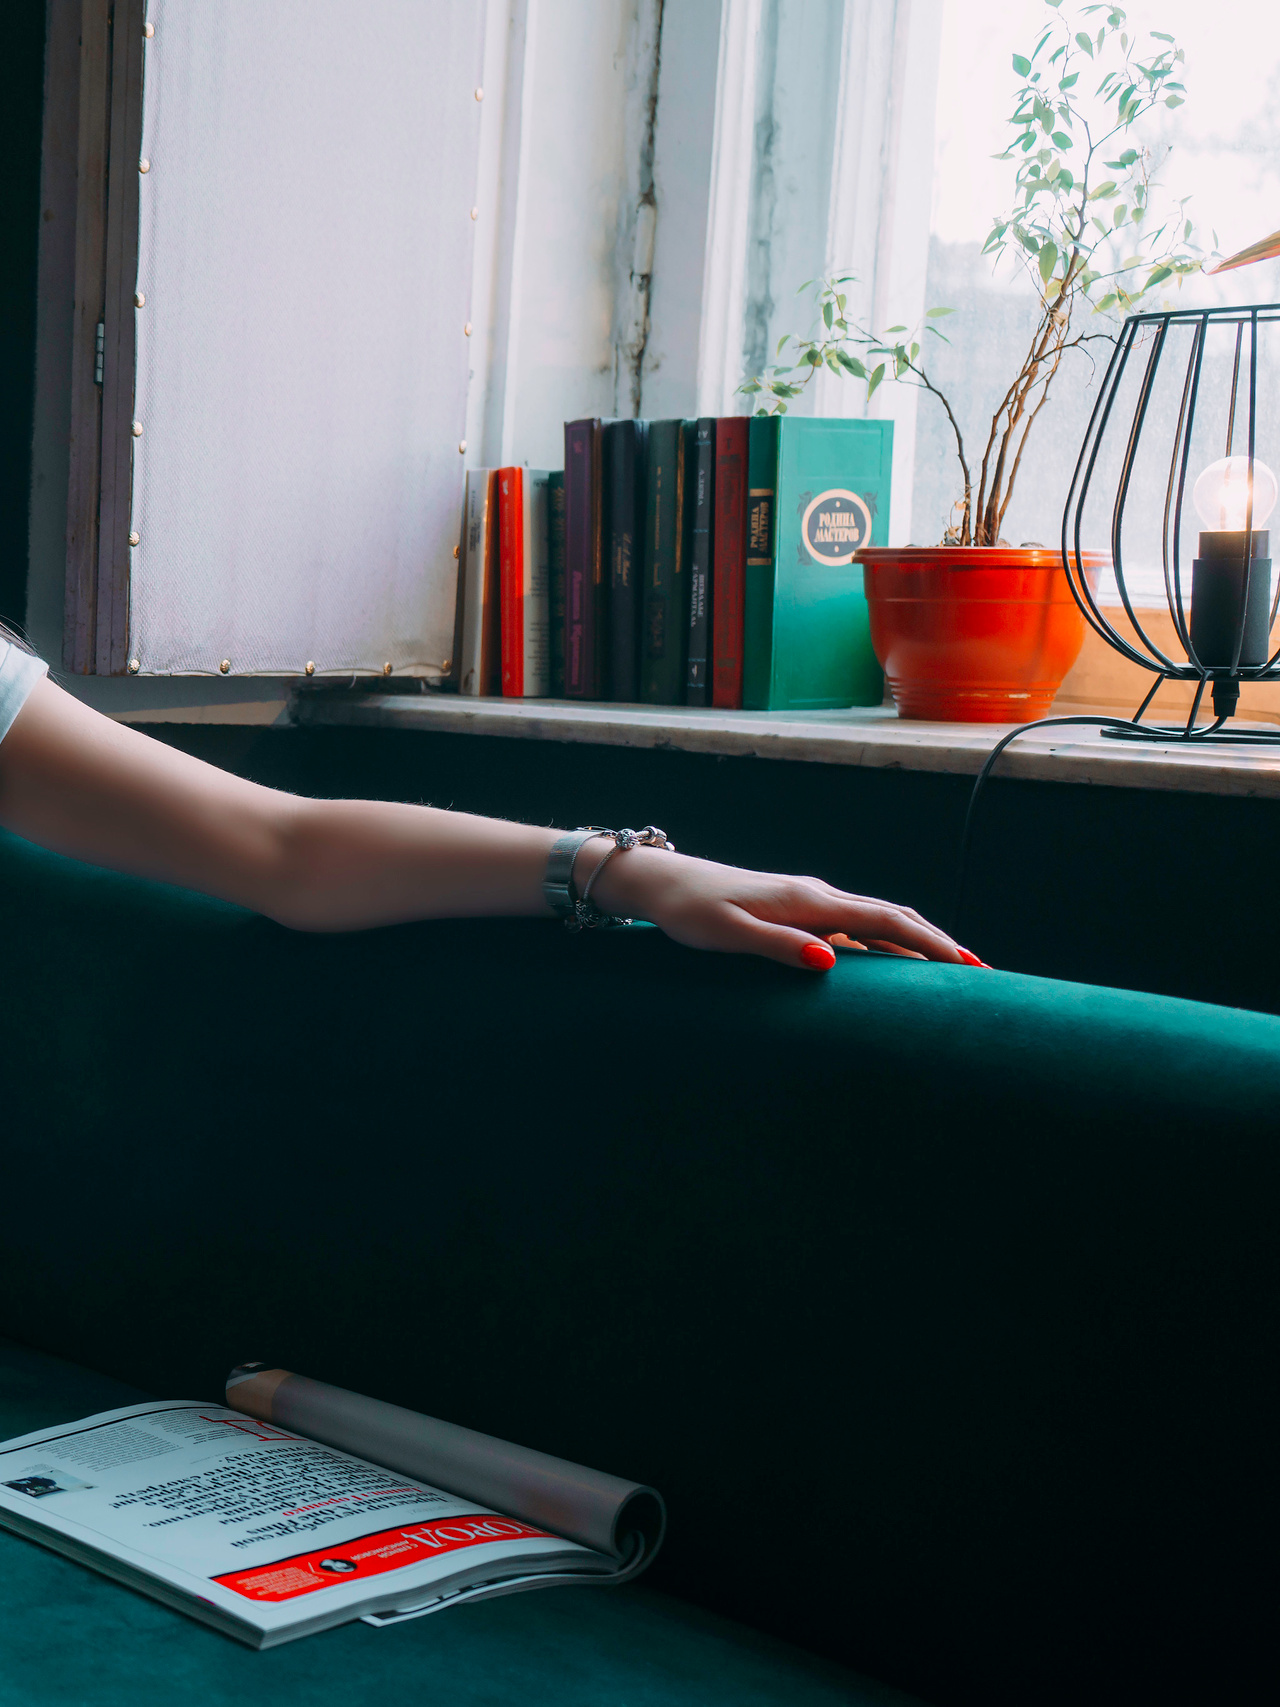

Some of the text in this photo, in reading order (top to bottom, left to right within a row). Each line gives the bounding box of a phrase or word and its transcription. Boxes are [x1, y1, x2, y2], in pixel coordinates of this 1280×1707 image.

[750, 506, 761, 550] РОДИНА
[818, 512, 856, 528] РОДИНА
[814, 527, 860, 543] МАСТЕРОВ
[217, 1451, 264, 1462] году.
[264, 1464, 355, 1481] Петербург
[114, 1475, 201, 1498] смотреть
[258, 1481, 326, 1497] России
[161, 1491, 222, 1510] нашей
[351, 1492, 439, 1506] компании
[143, 1497, 261, 1527] Соррентино,
[217, 1501, 300, 1524] фильмы
[231, 1496, 452, 1548] Директор петербургской
[245, 1519, 299, 1534] Films
[400, 1521, 544, 1548] ГОРОД
